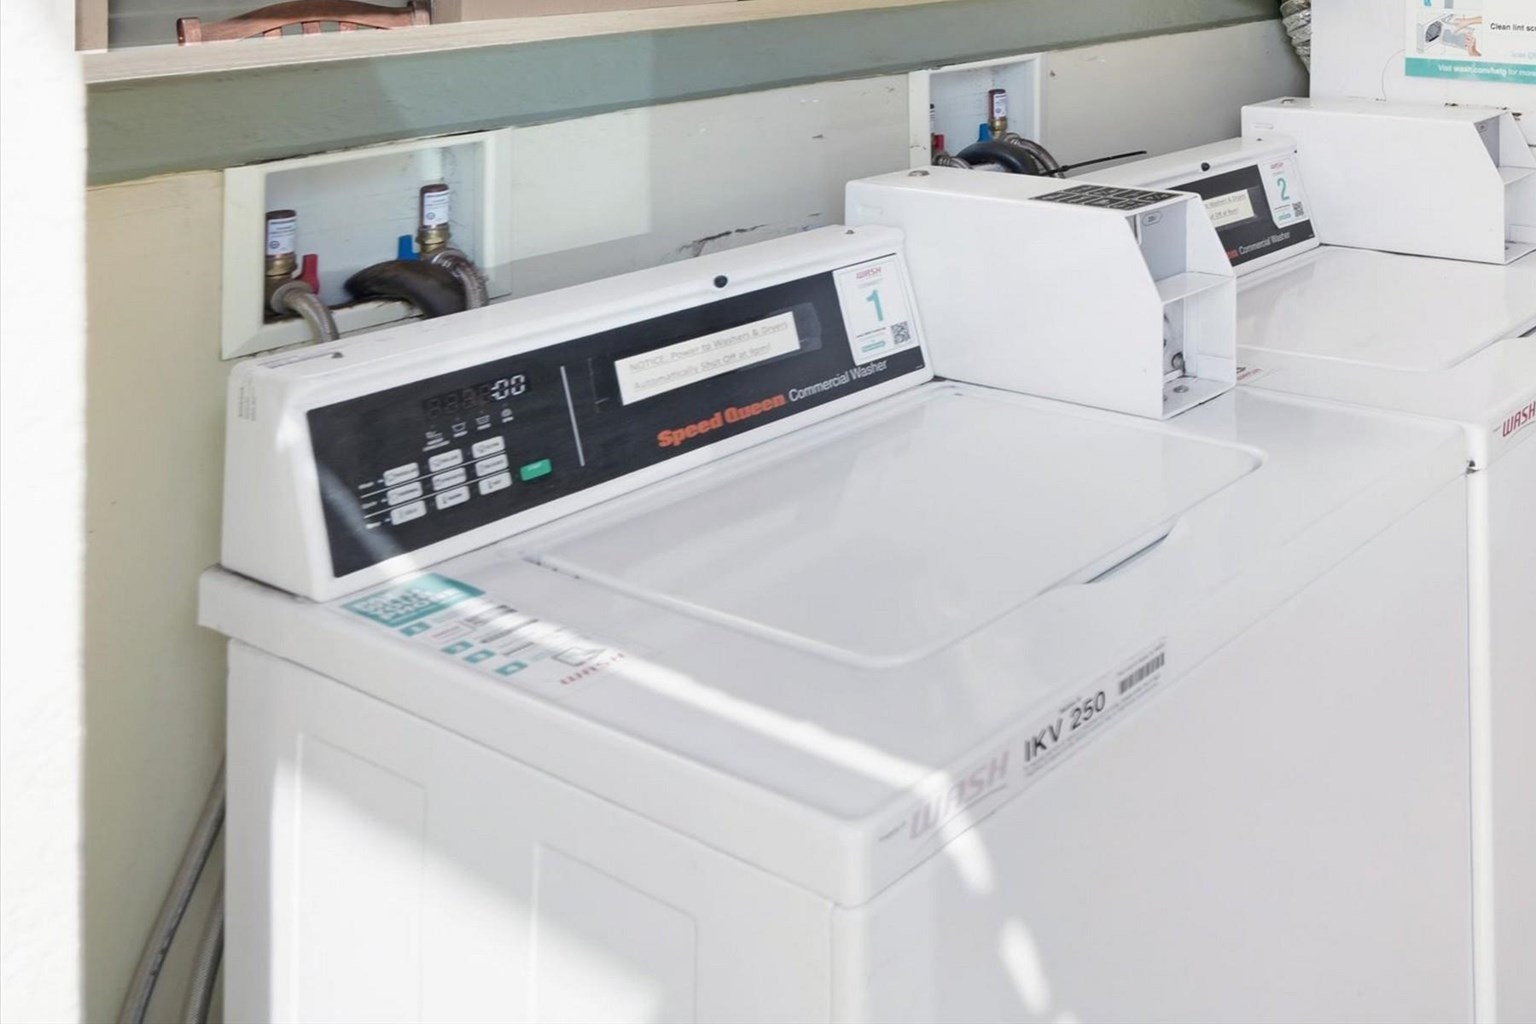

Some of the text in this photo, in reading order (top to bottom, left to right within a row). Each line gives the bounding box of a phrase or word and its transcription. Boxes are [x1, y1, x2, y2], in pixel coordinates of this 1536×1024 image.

[1490, 23, 1511, 31] Clean
[1277, 178, 1290, 200] 2
[867, 290, 883, 321] 1
[670, 347, 698, 360] Power
[702, 343, 711, 353] to
[723, 353, 736, 363] Off
[657, 359, 887, 447] Speed Queen Commercial Washer
[1502, 401, 1536, 437] WASH
[1024, 718, 1062, 762] IKV
[1071, 691, 1106, 730] 250
